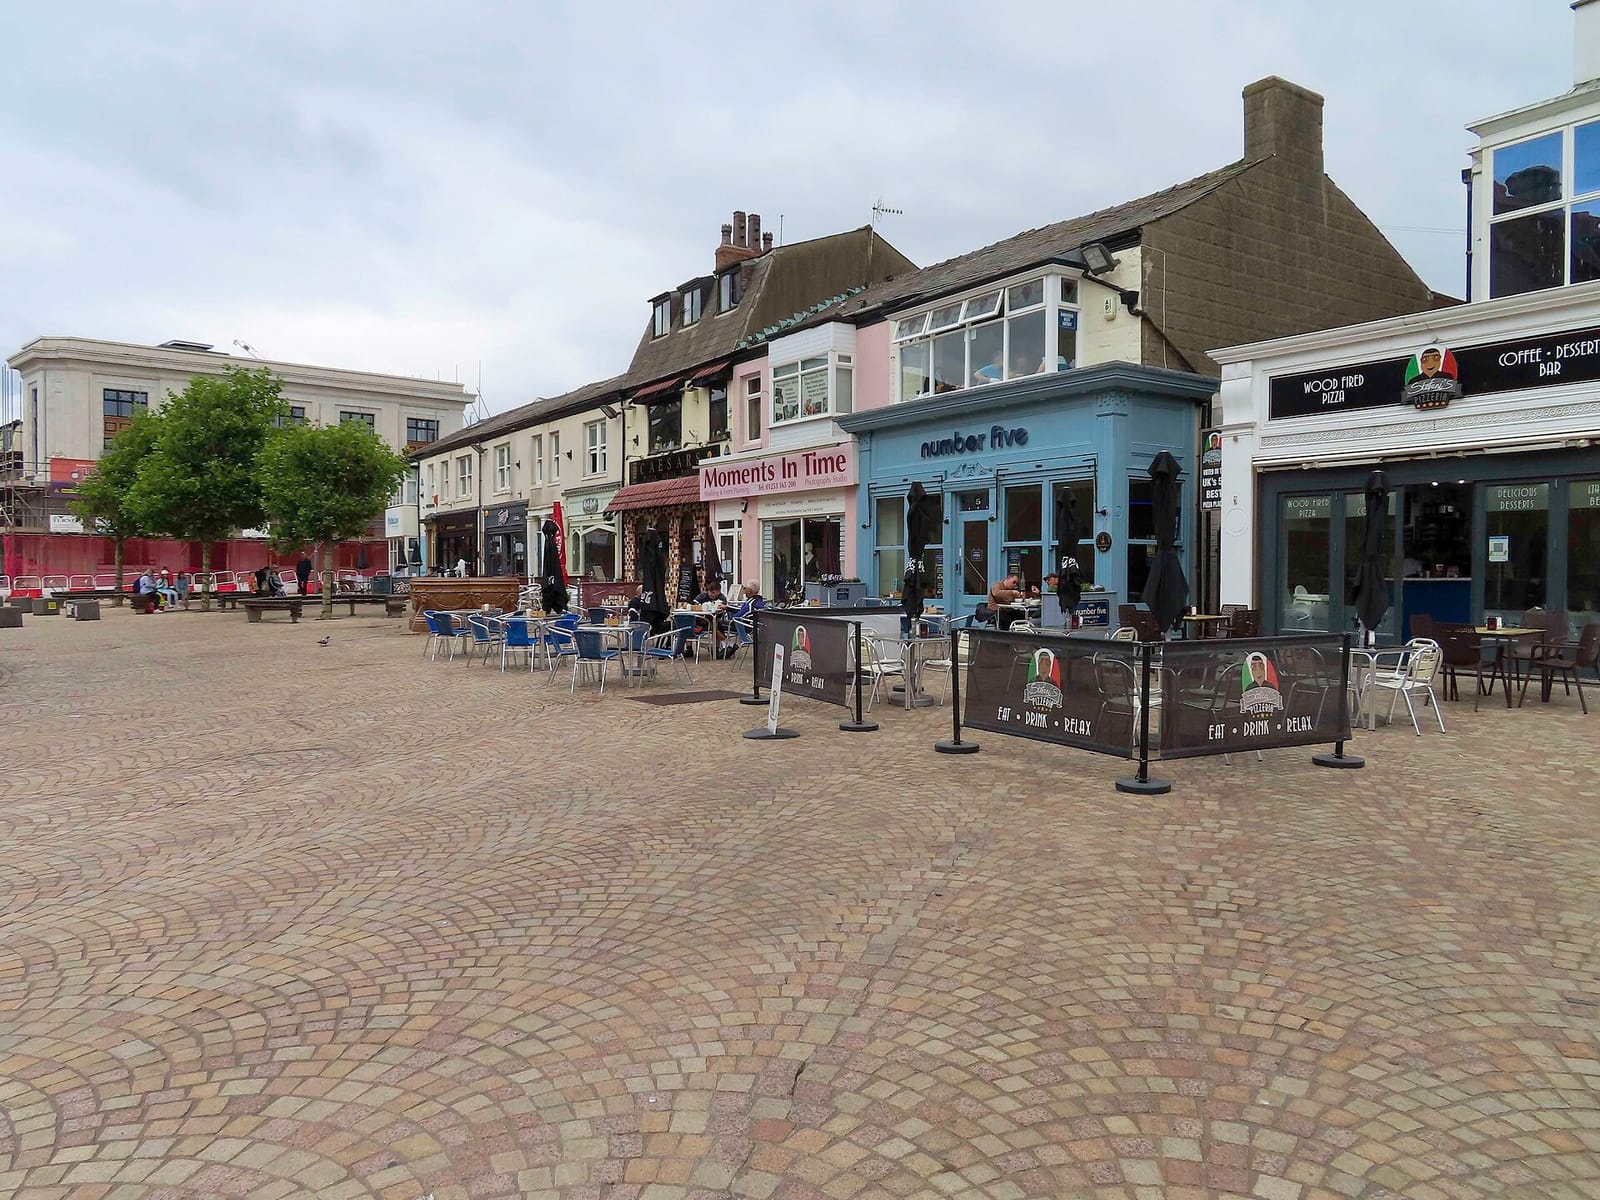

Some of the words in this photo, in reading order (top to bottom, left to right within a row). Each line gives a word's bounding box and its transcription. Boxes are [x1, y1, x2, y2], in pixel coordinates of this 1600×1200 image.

[1498, 348, 1542, 366] COFFEE
[1540, 362, 1561, 376] BAR
[1303, 379, 1338, 394] WOOD
[1341, 374, 1364, 388] FIRED
[1322, 389, 1345, 404] PIZZA
[921, 431, 986, 459] number
[990, 425, 1028, 450] five
[640, 452, 700, 475] CAESARS
[704, 461, 775, 489] Moments
[782, 457, 797, 479] In
[802, 451, 846, 476] Time
[1497, 487, 1537, 498] DELICIOUS
[975, 498, 982, 506] 5
[1287, 499, 1309, 508] WOOD
[1312, 498, 1330, 507] FIRED
[1500, 499, 1535, 510] DESSERTS
[1299, 509, 1316, 518] PIZZA
[997, 706, 1011, 722] EAT
[1025, 711, 1048, 729] DRINK
[1064, 717, 1091, 736] RELAX
[1208, 723, 1226, 740] EAT
[1243, 719, 1270, 737] DRINK
[1286, 715, 1313, 733] RELAX
